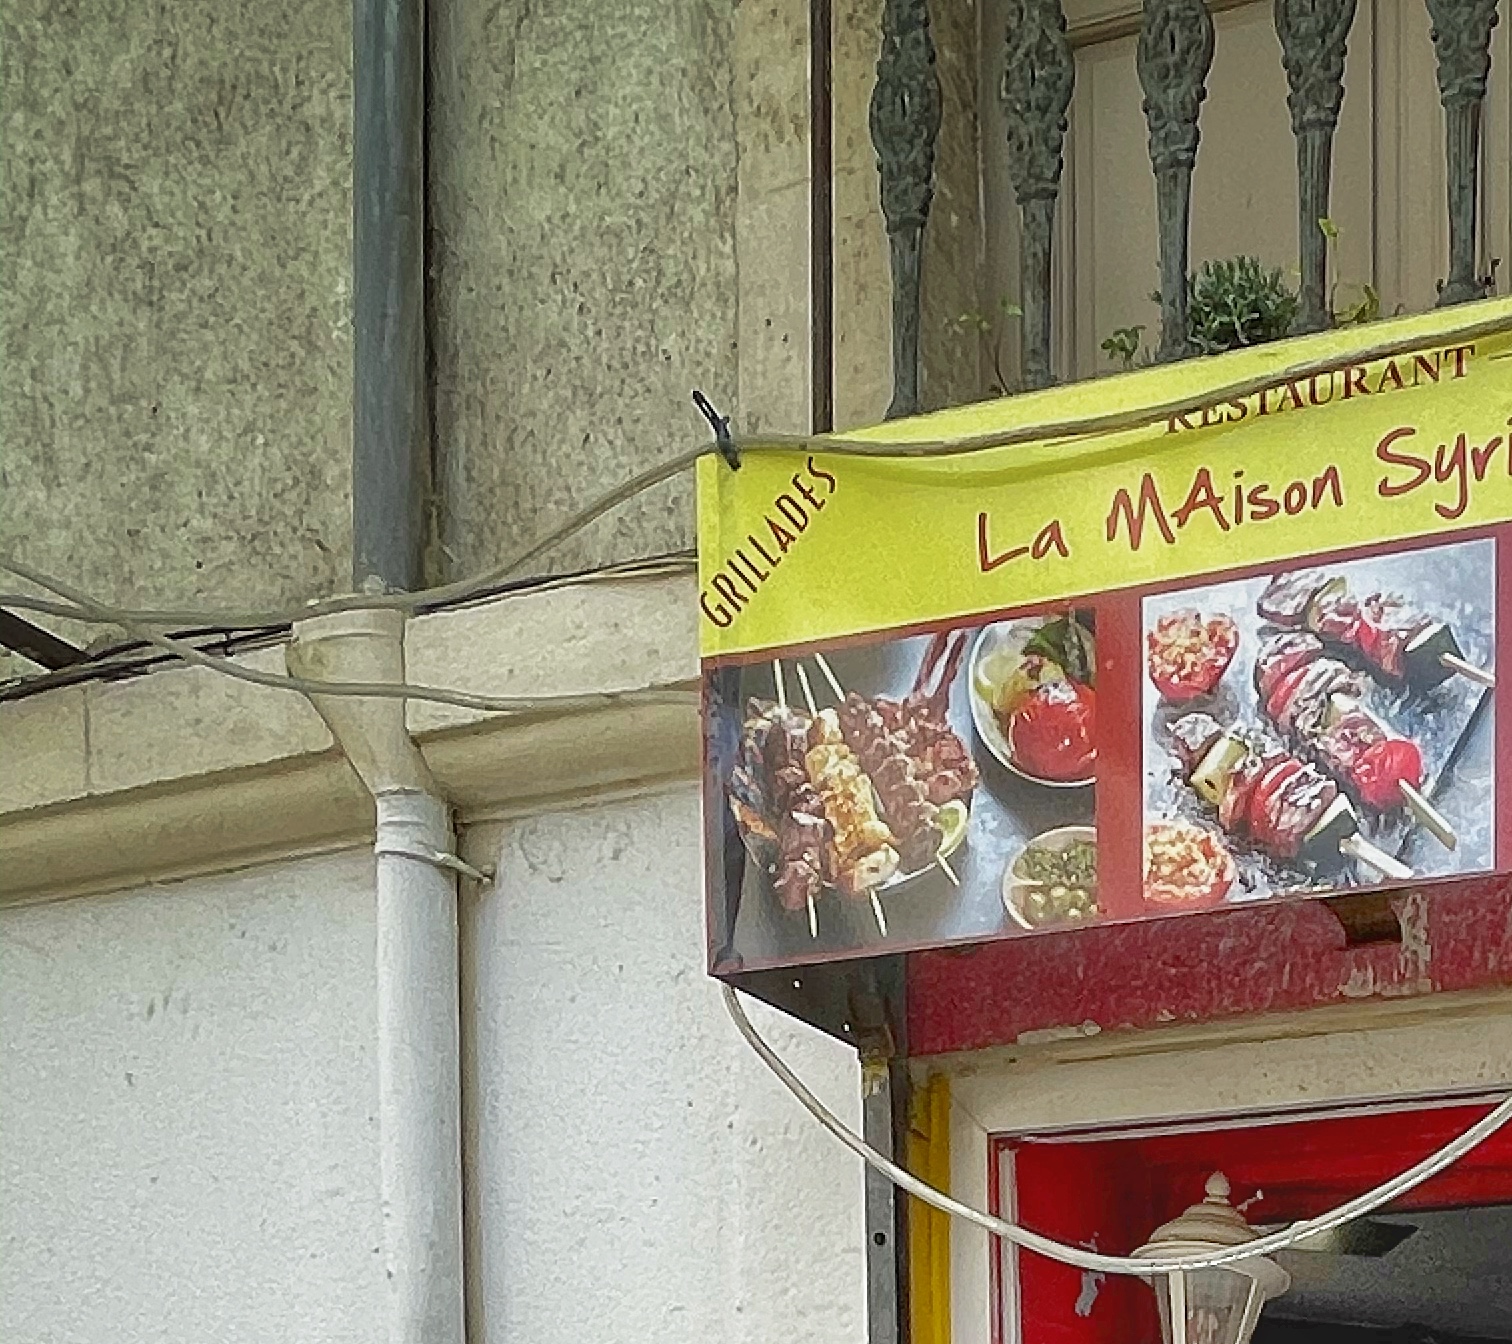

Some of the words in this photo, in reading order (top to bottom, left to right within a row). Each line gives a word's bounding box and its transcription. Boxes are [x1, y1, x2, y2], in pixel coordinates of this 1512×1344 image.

[1165, 345, 1475, 433] RESTAURANT
[701, 456, 836, 628] GRILLADES
[977, 511, 1068, 572] La
